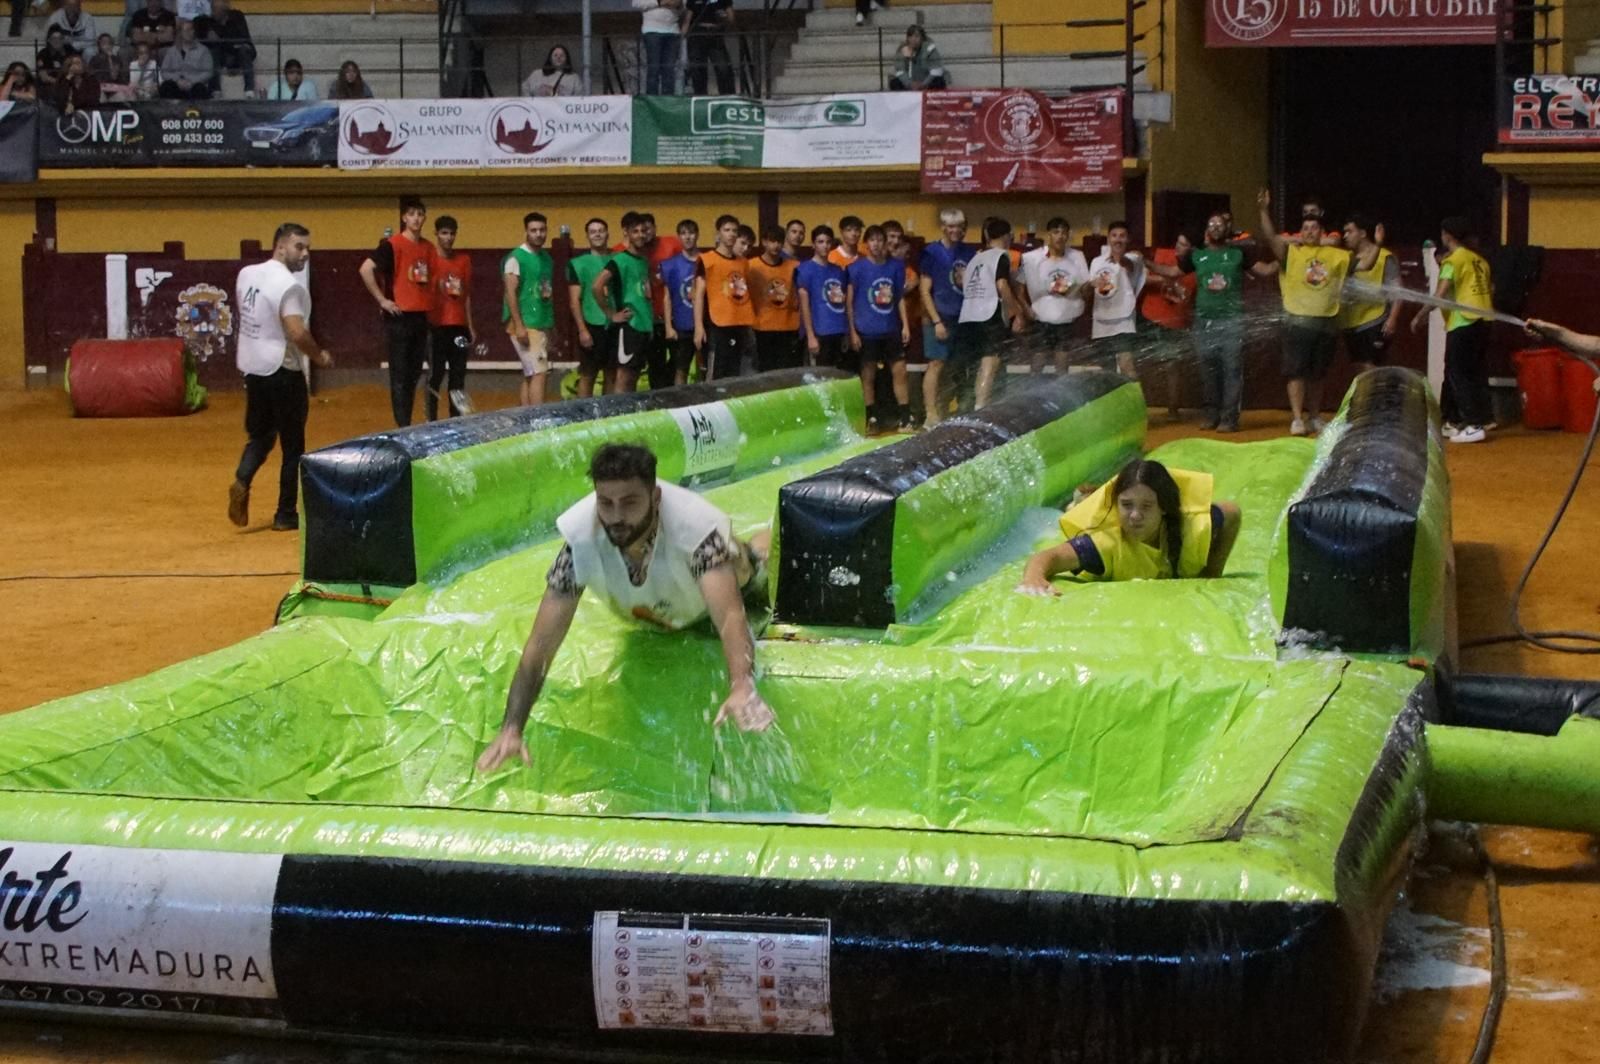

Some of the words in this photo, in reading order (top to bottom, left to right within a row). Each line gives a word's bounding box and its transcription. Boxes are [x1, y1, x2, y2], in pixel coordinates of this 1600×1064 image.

[1333, 0, 1360, 17] DE
[419, 106, 462, 117] GRUPO
[565, 103, 609, 114] GRUPO
[725, 105, 762, 121] est
[91, 110, 140, 141] MP
[161, 120, 180, 130] 608
[183, 119, 202, 129] 007
[204, 120, 224, 130] 600
[399, 121, 482, 139] SALMANTINA
[545, 120, 630, 137] SALMANTINA
[162, 134, 181, 143] 609
[183, 133, 202, 143] 433
[204, 133, 224, 143] 032
[342, 159, 422, 167] CONSTRUCCIONES
[432, 158, 480, 166] REFORMAS
[487, 157, 567, 165] CONSTRUCCIONES
